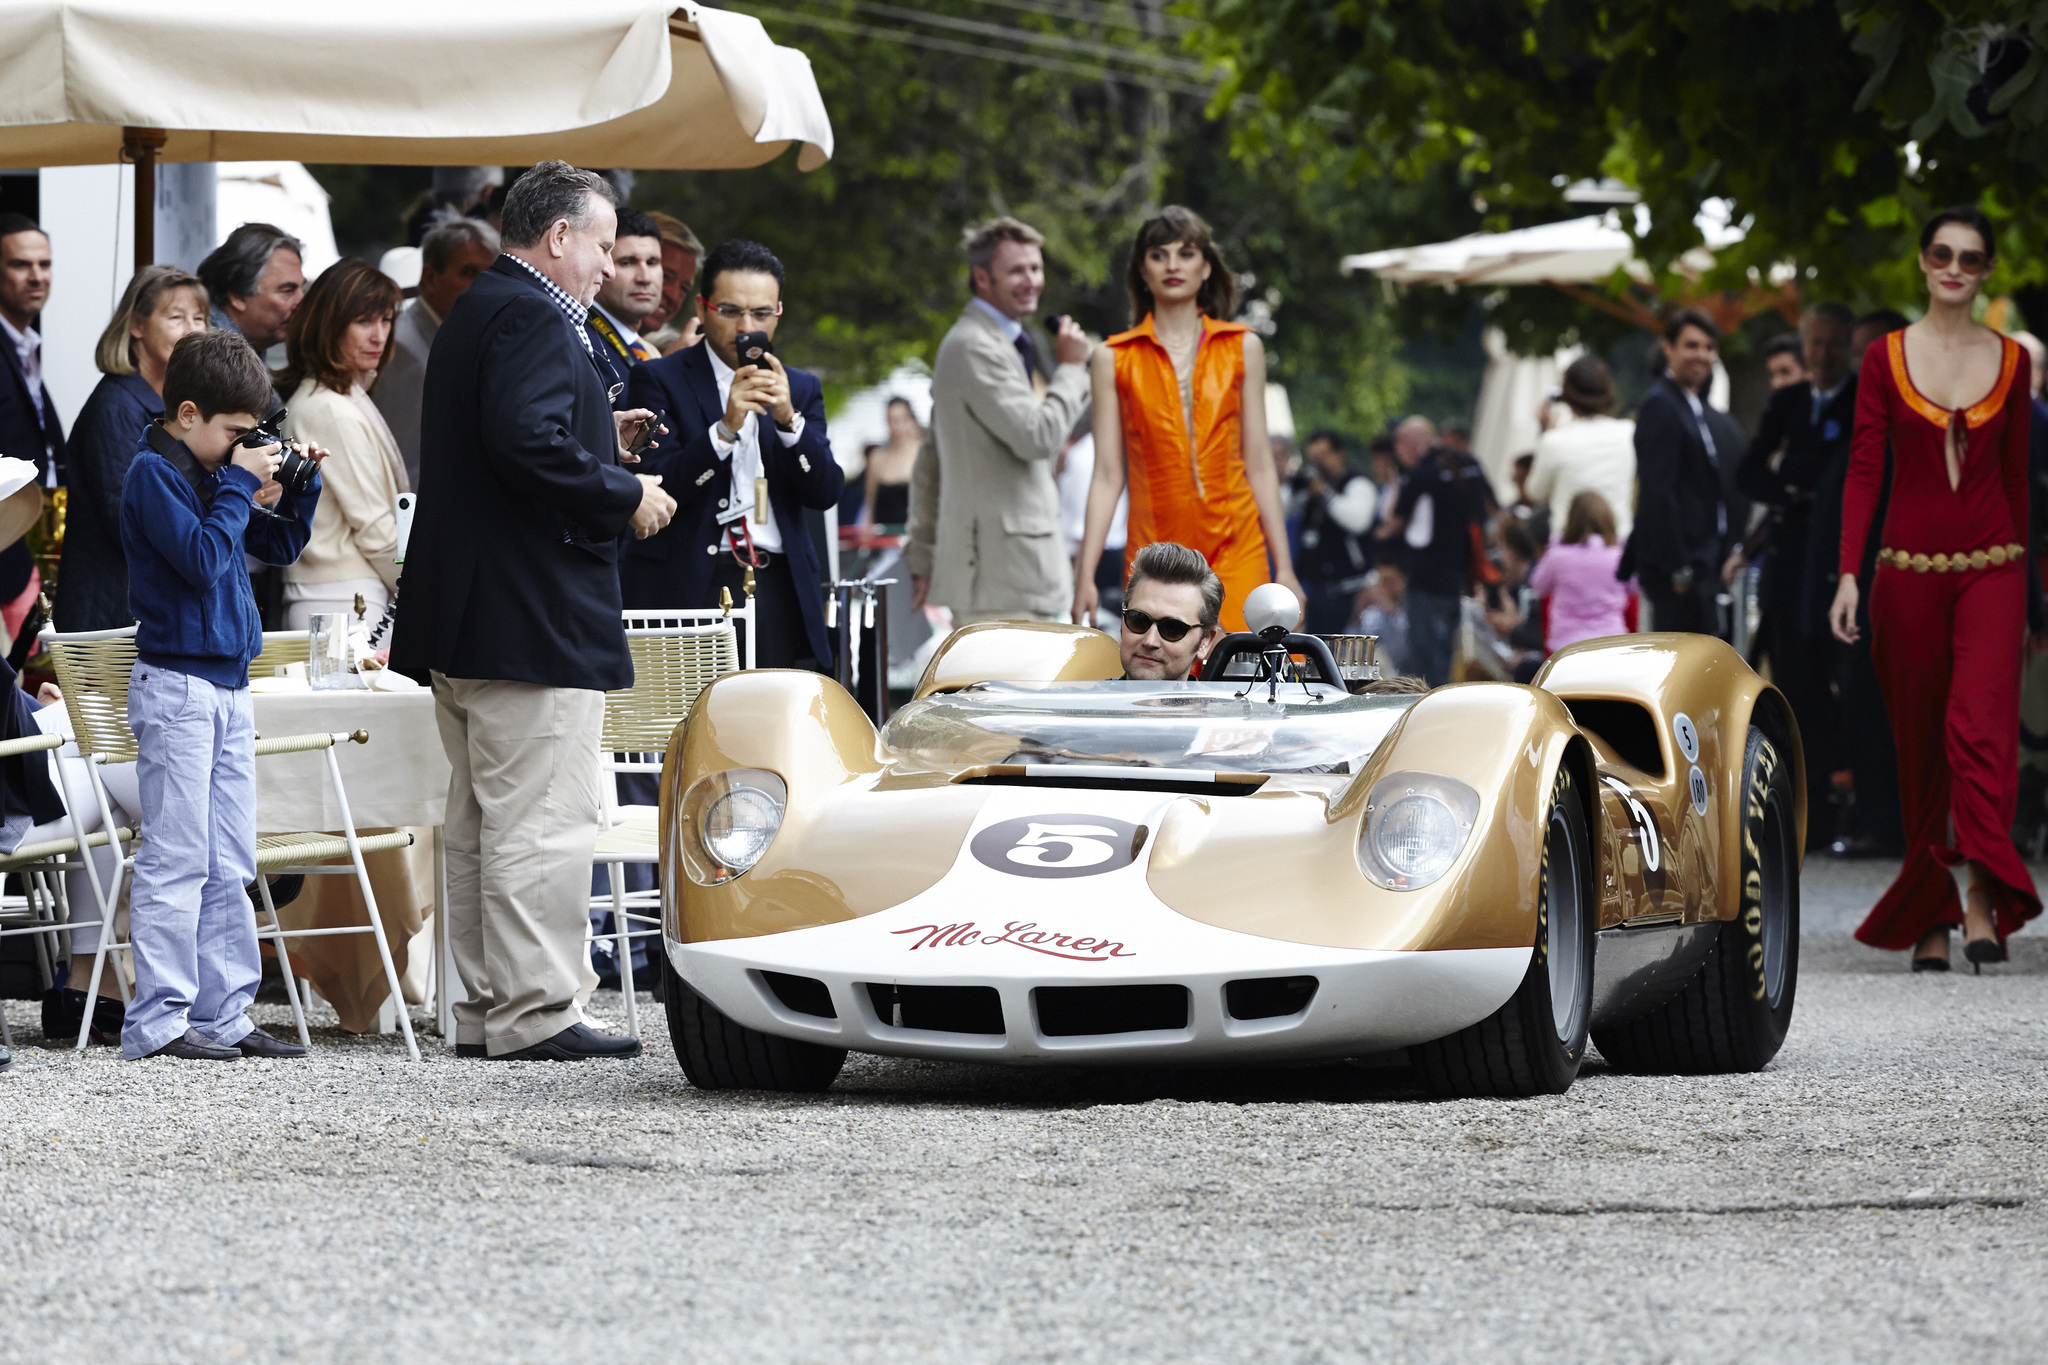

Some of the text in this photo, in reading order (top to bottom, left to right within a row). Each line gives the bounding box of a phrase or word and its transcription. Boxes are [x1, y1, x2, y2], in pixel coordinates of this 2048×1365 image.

[1681, 725, 1692, 750] 5
[1691, 778, 1705, 803] 180
[1600, 776, 1660, 872] 5
[1006, 822, 1118, 868] 5
